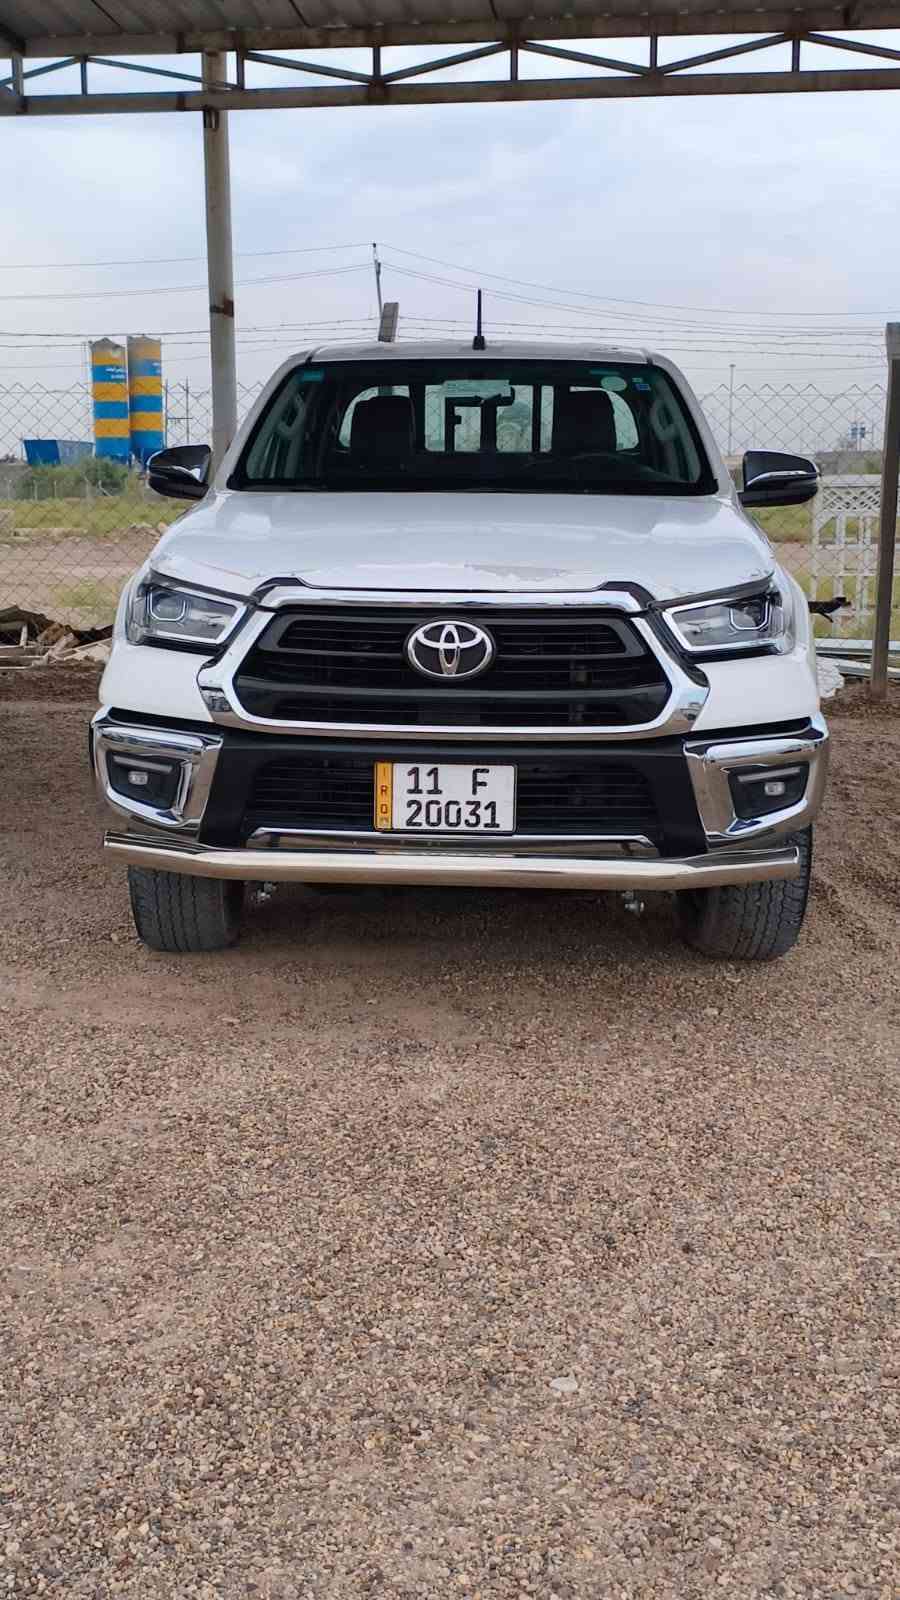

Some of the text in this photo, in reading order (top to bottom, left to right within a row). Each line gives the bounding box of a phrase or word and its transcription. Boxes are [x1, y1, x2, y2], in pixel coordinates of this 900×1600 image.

[407, 767, 490, 796] 11 F
[405, 799, 500, 828] 20031
